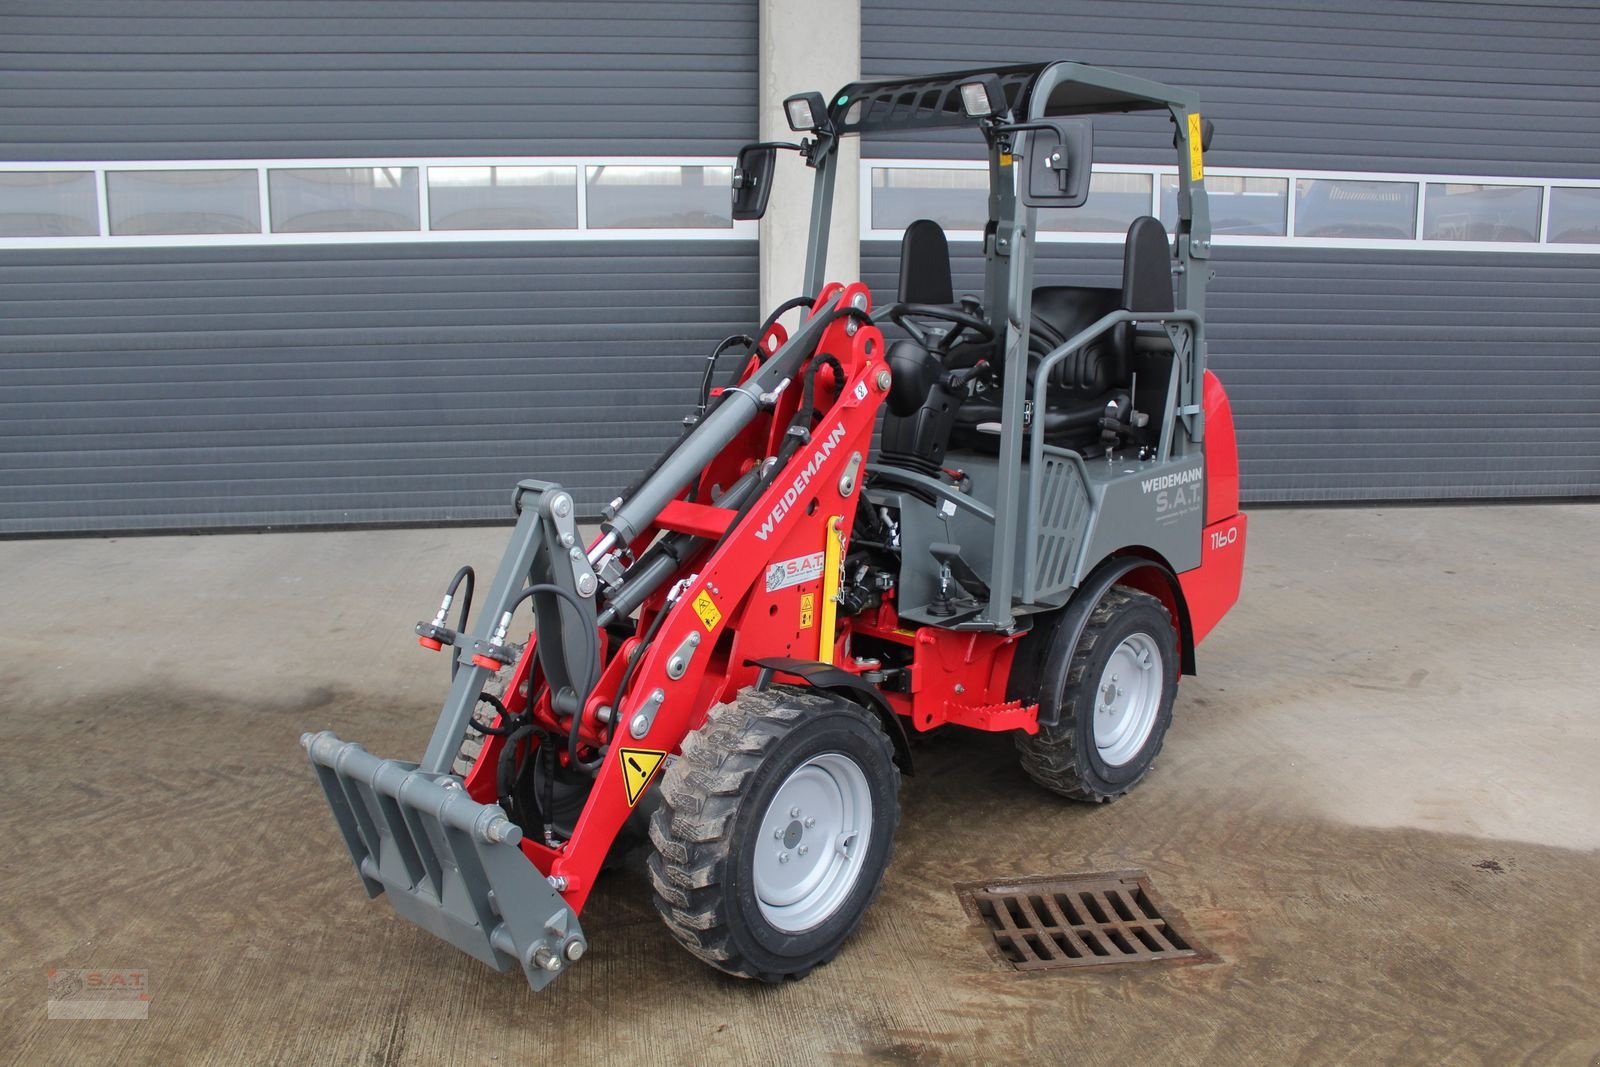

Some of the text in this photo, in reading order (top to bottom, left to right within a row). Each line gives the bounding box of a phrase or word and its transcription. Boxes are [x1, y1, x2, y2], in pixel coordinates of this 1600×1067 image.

[754, 421, 847, 541] WEIDEMANN
[1141, 467, 1203, 494] WEIDEMANN
[1156, 483, 1201, 512] S.A.T.
[1210, 527, 1238, 550] 1160
[786, 554, 824, 575] S.A.T.
